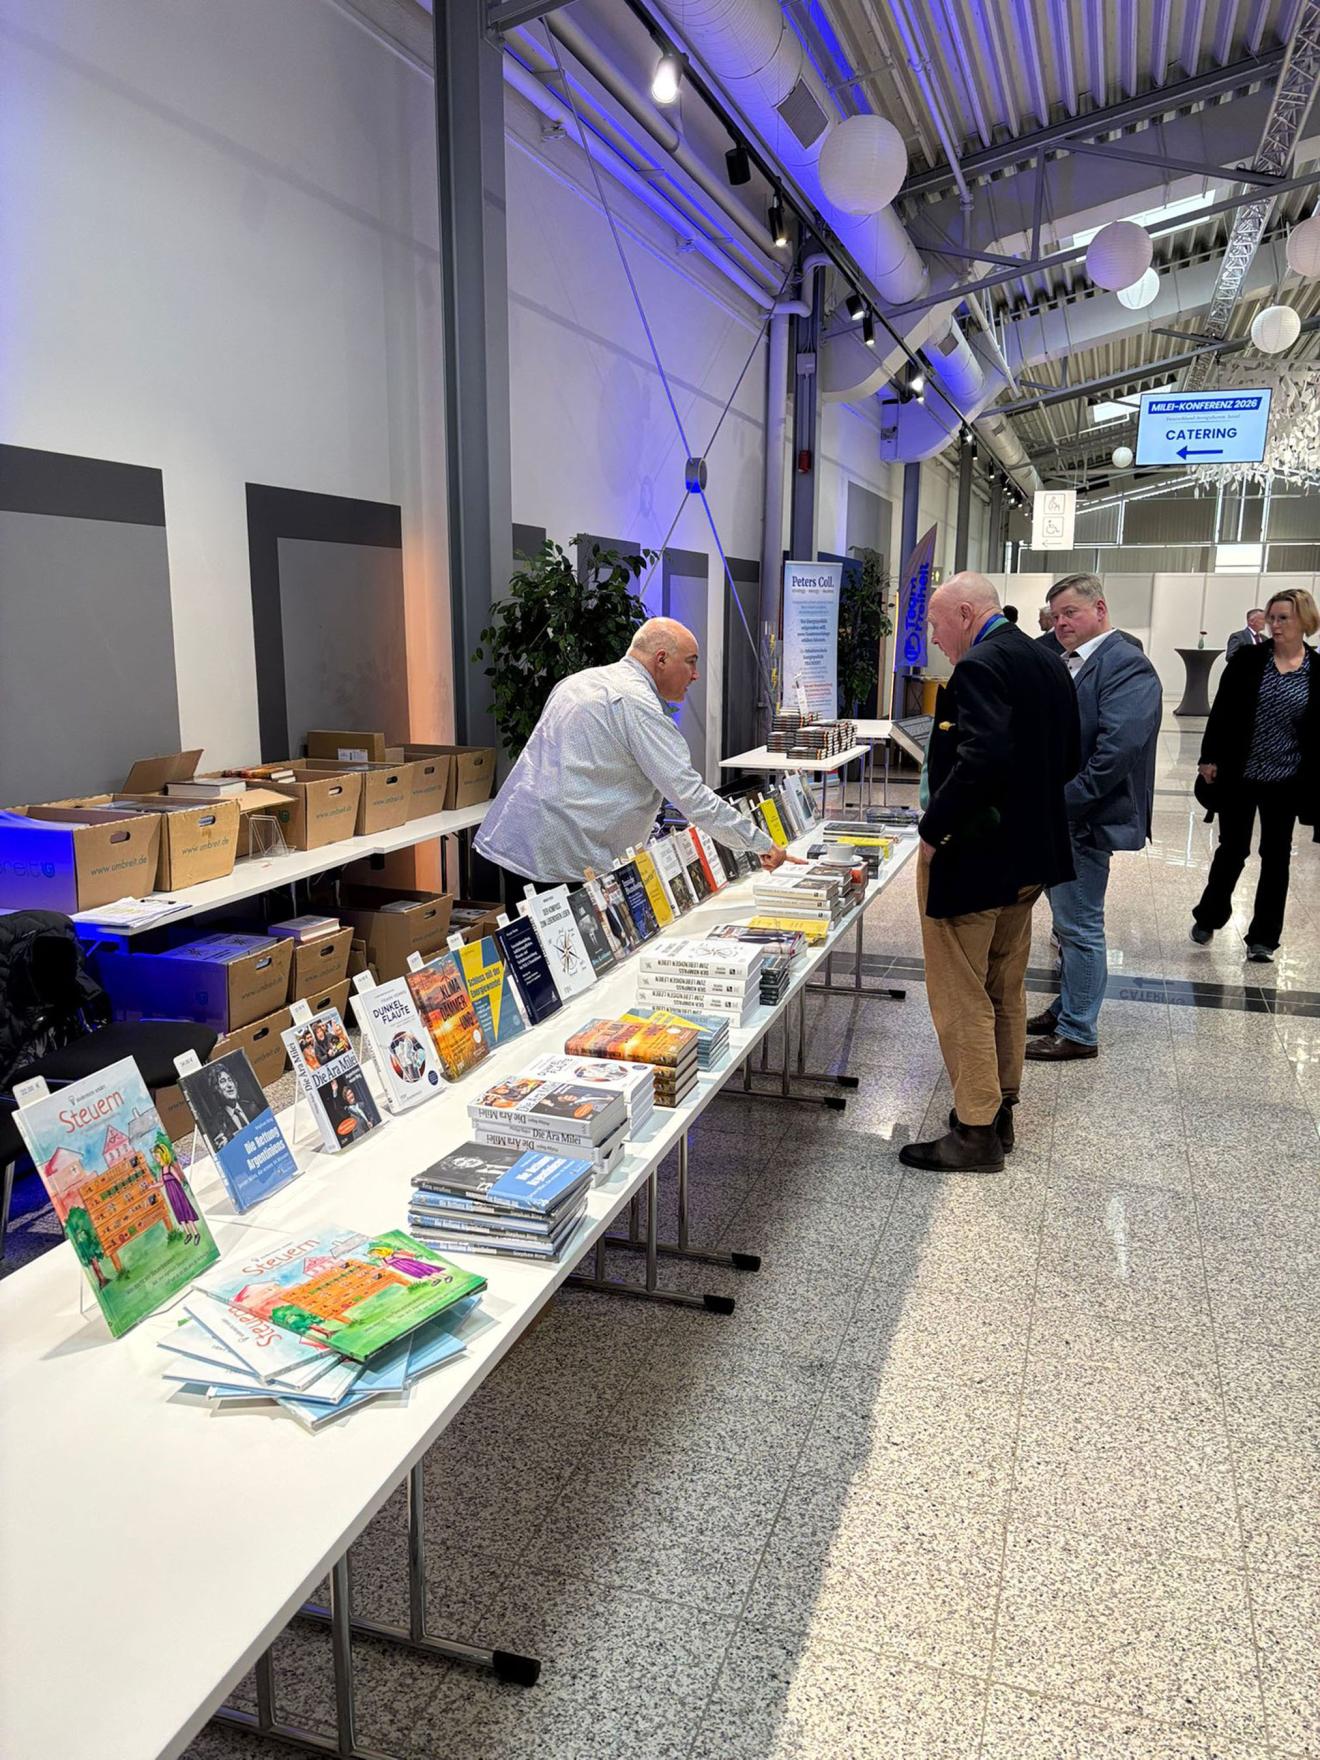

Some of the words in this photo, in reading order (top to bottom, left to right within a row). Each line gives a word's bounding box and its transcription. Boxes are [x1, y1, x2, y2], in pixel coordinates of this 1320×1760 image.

[1151, 399, 1233, 412] MILEI-KONFERENZ
[1234, 398, 1258, 409] 2026
[1165, 427, 1238, 441] CATERING
[792, 575, 817, 588] Peters
[818, 575, 835, 588] Coll.
[905, 576, 917, 631] Team
[914, 562, 930, 632] Freiheit
[90, 855, 147, 876] www.umbreit.de
[373, 999, 404, 1018] DUNKEL
[382, 1005, 411, 1025] FLAUTE
[312, 1070, 328, 1089] Die
[340, 1054, 358, 1073] Milei
[59, 1091, 125, 1134] Steuern
[478, 1107, 499, 1120] Milei
[513, 1113, 527, 1125] Die
[486, 1133, 507, 1146] Milei
[521, 1140, 535, 1151] Die
[532, 1128, 547, 1139] Die
[560, 1131, 582, 1145] Milei
[242, 1240, 320, 1276] Steuern
